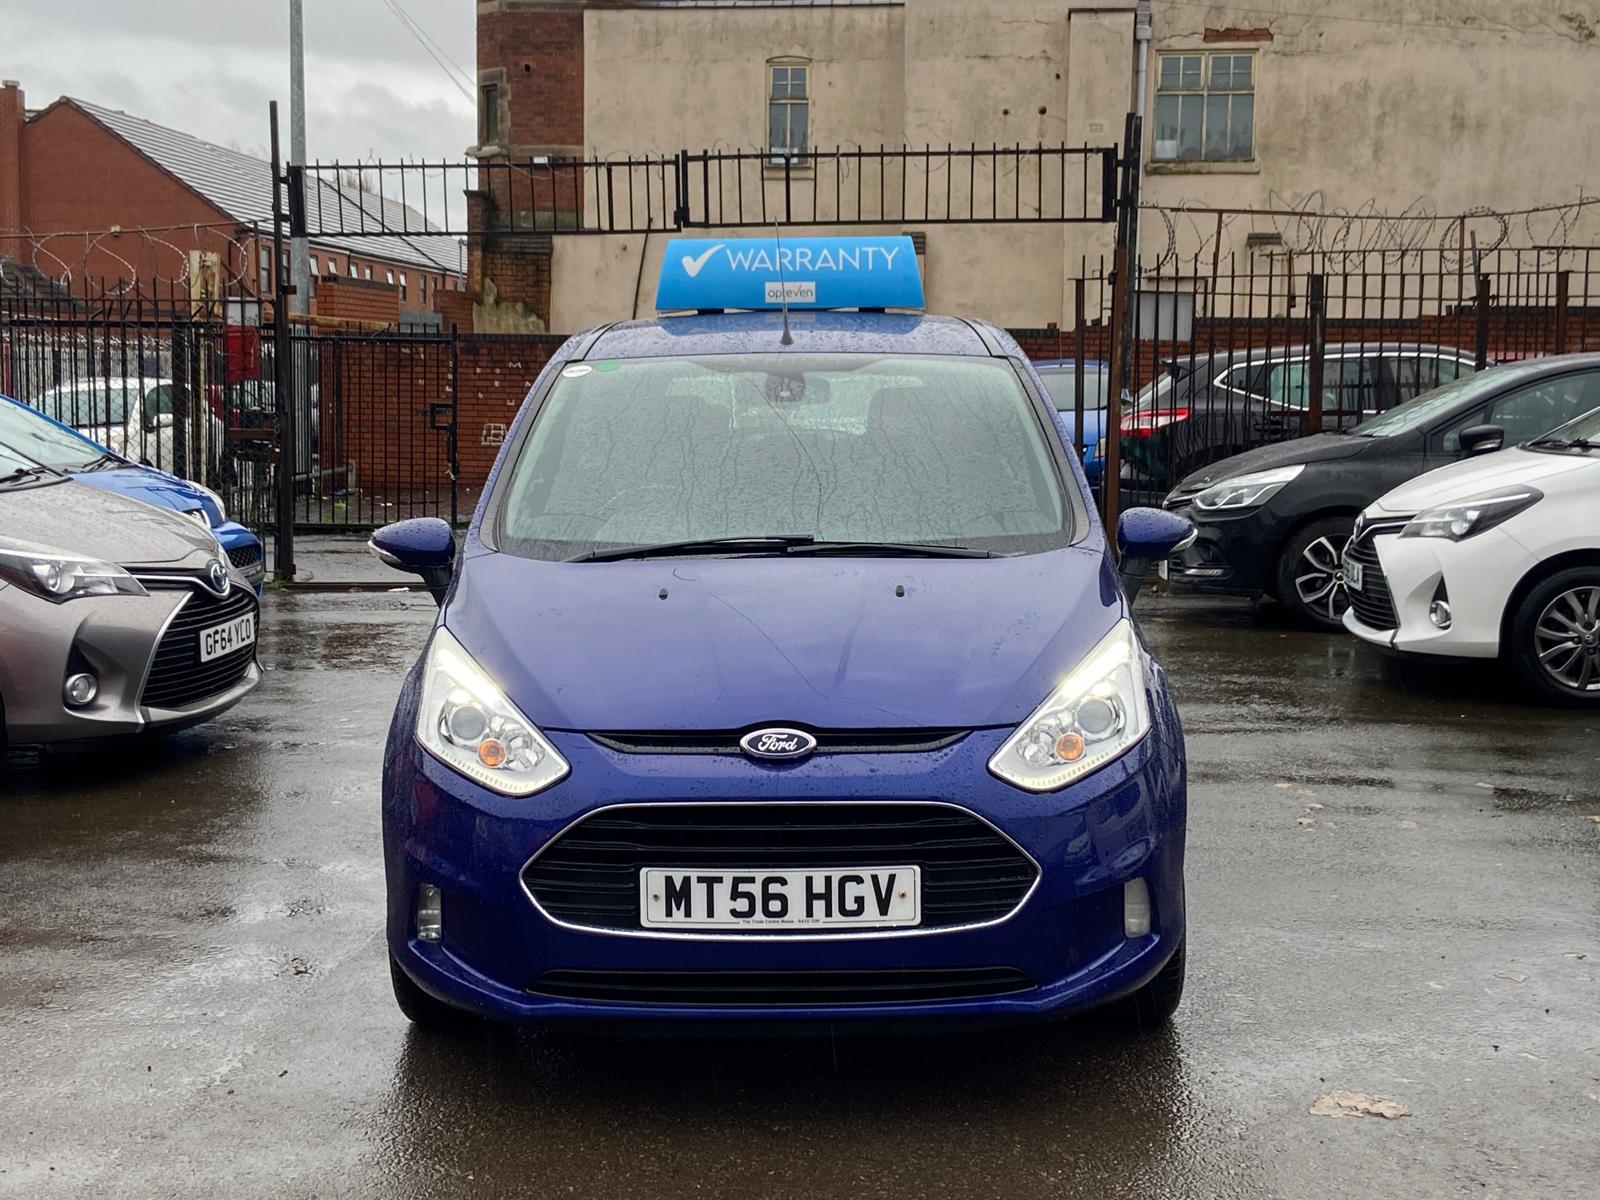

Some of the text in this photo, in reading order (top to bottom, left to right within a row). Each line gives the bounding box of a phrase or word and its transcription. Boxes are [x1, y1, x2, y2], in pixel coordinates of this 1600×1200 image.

[726, 247, 900, 271] WARRANTY
[205, 624, 233, 656] GF64
[757, 733, 798, 751] Ford
[664, 873, 897, 919] MT56 HGV
